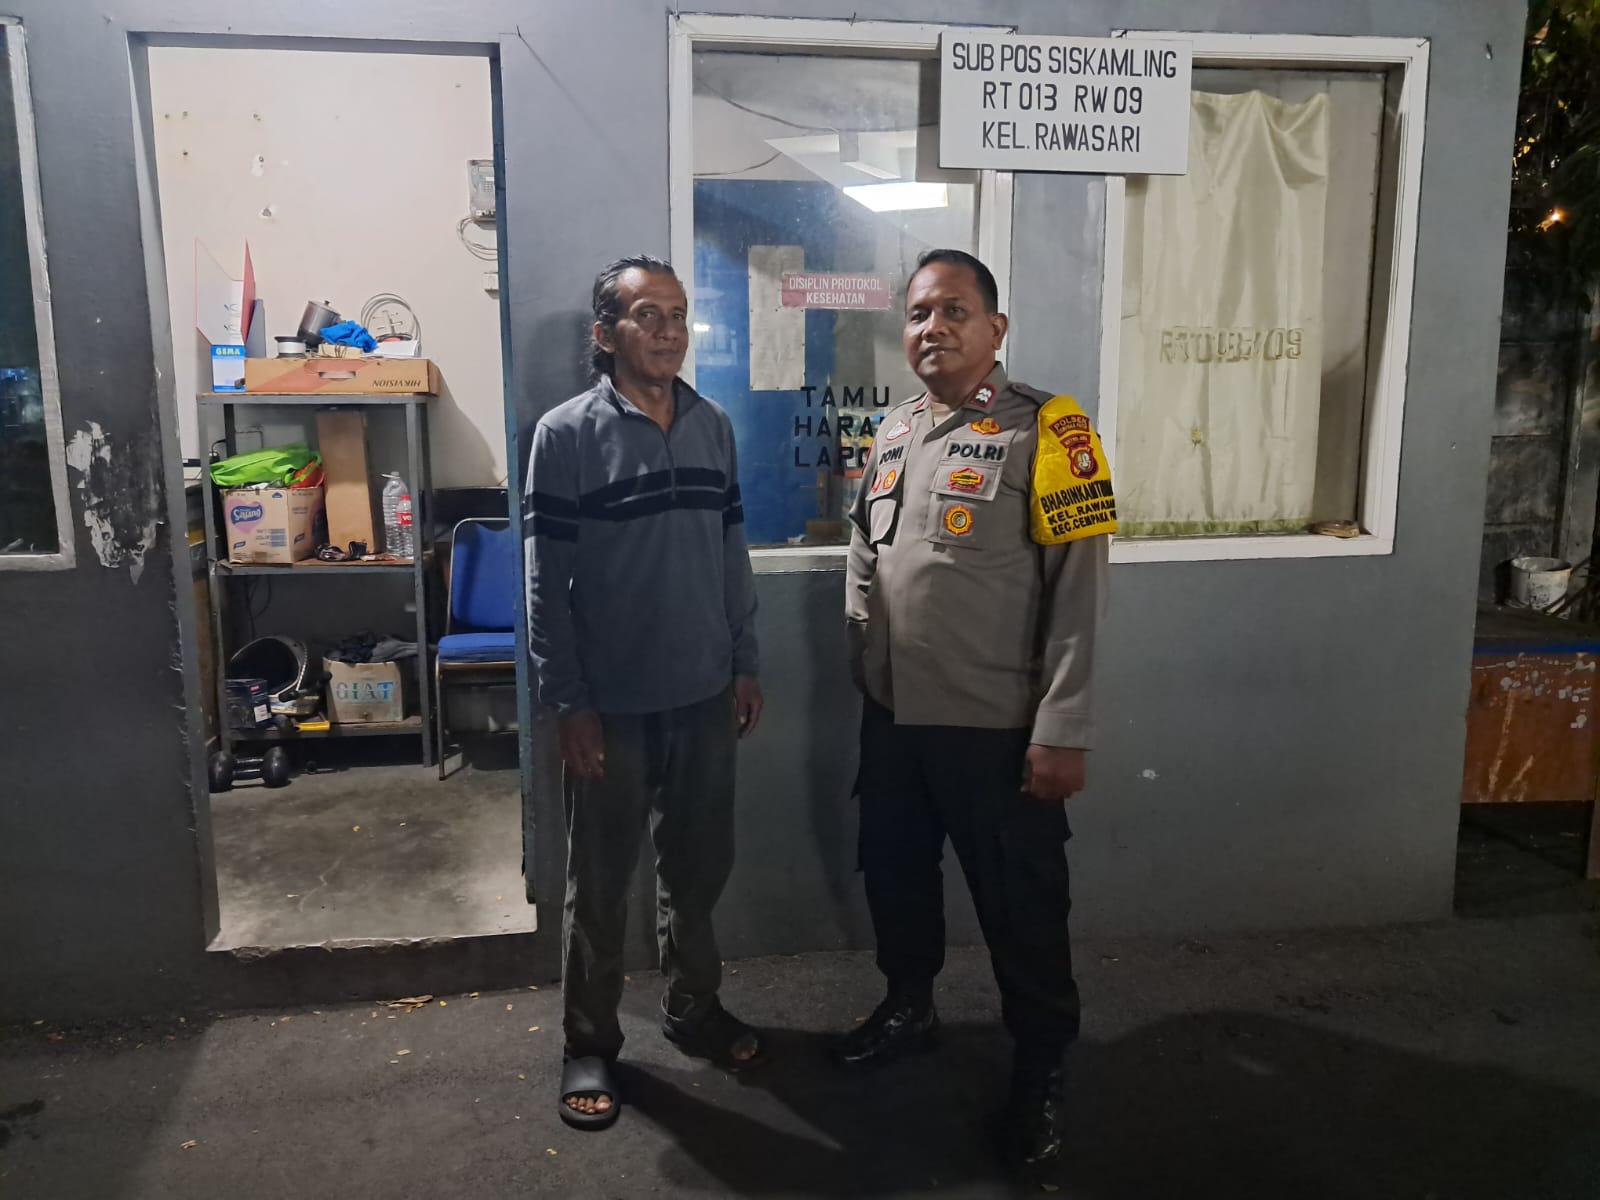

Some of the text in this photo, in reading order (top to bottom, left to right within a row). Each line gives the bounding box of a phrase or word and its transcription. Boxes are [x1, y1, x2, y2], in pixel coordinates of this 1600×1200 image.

[952, 42, 1177, 79] SUB POS SISKAMLING
[983, 81, 1142, 115] RT 013 RW 09
[789, 277, 882, 290] DISIPLIN PROTOKOL
[806, 292, 865, 305] KESEHATAN
[372, 379, 422, 388] HIKVISION
[800, 386, 890, 408] TAMU
[794, 415, 886, 437] HARA
[948, 442, 1006, 462] POLRI
